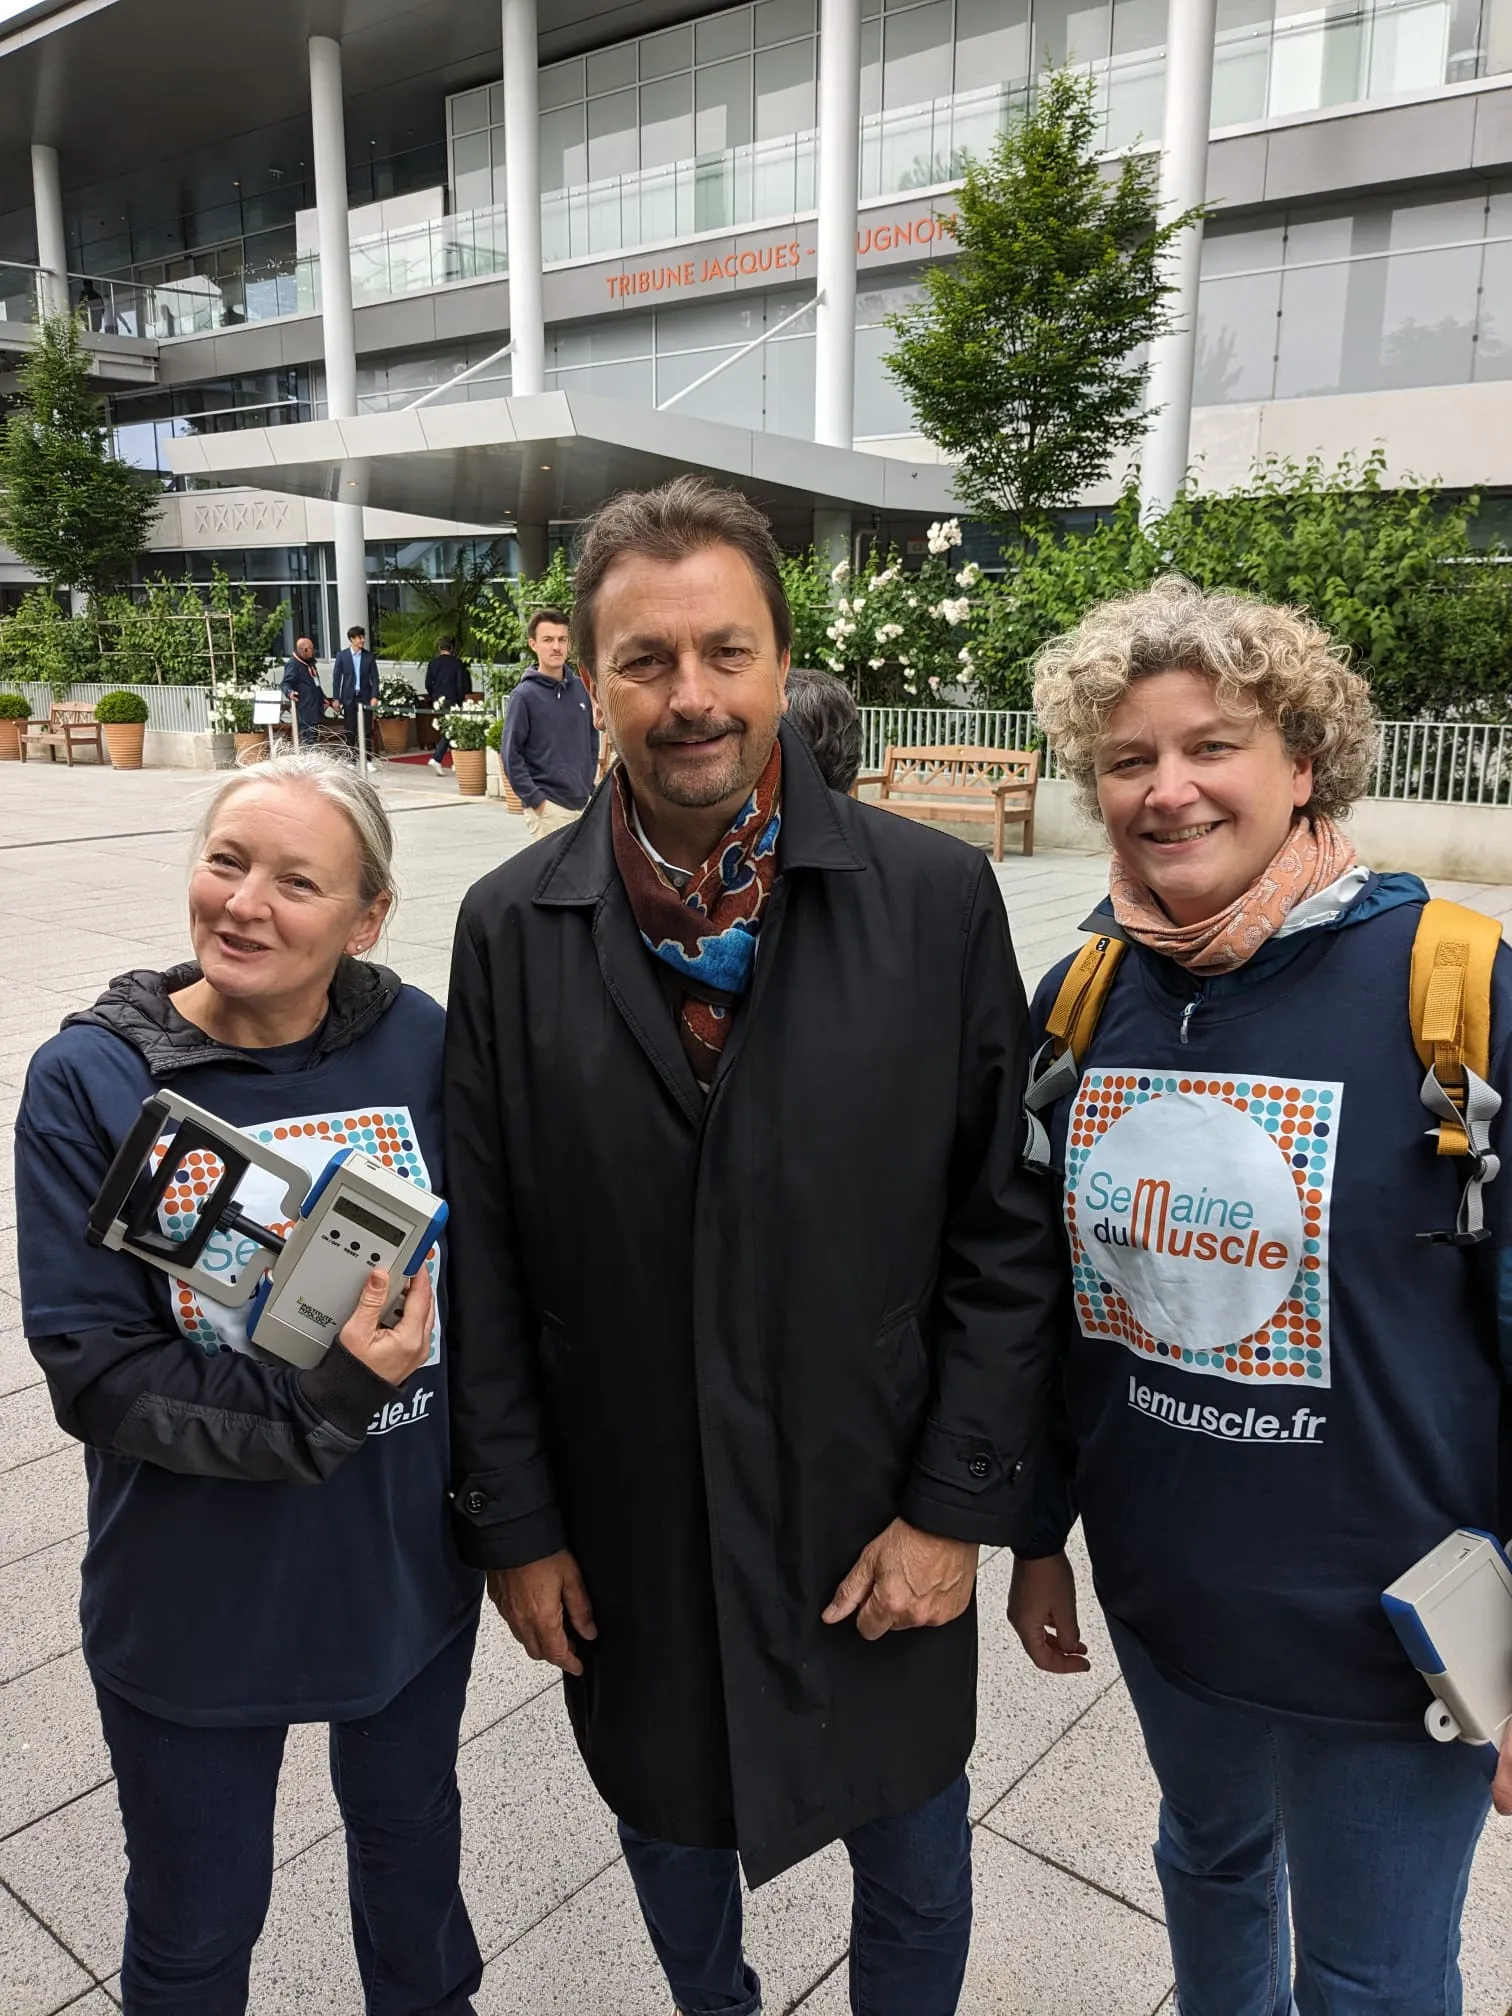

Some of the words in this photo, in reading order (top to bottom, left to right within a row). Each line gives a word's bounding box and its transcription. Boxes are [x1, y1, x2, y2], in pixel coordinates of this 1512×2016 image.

[606, 261, 695, 298] TRIBUNE
[700, 241, 800, 283] JACQUES
[855, 213, 957, 254] UGNON
[1094, 1217, 1130, 1247] du
[1128, 1376, 1326, 1439] lemuscle.fr
